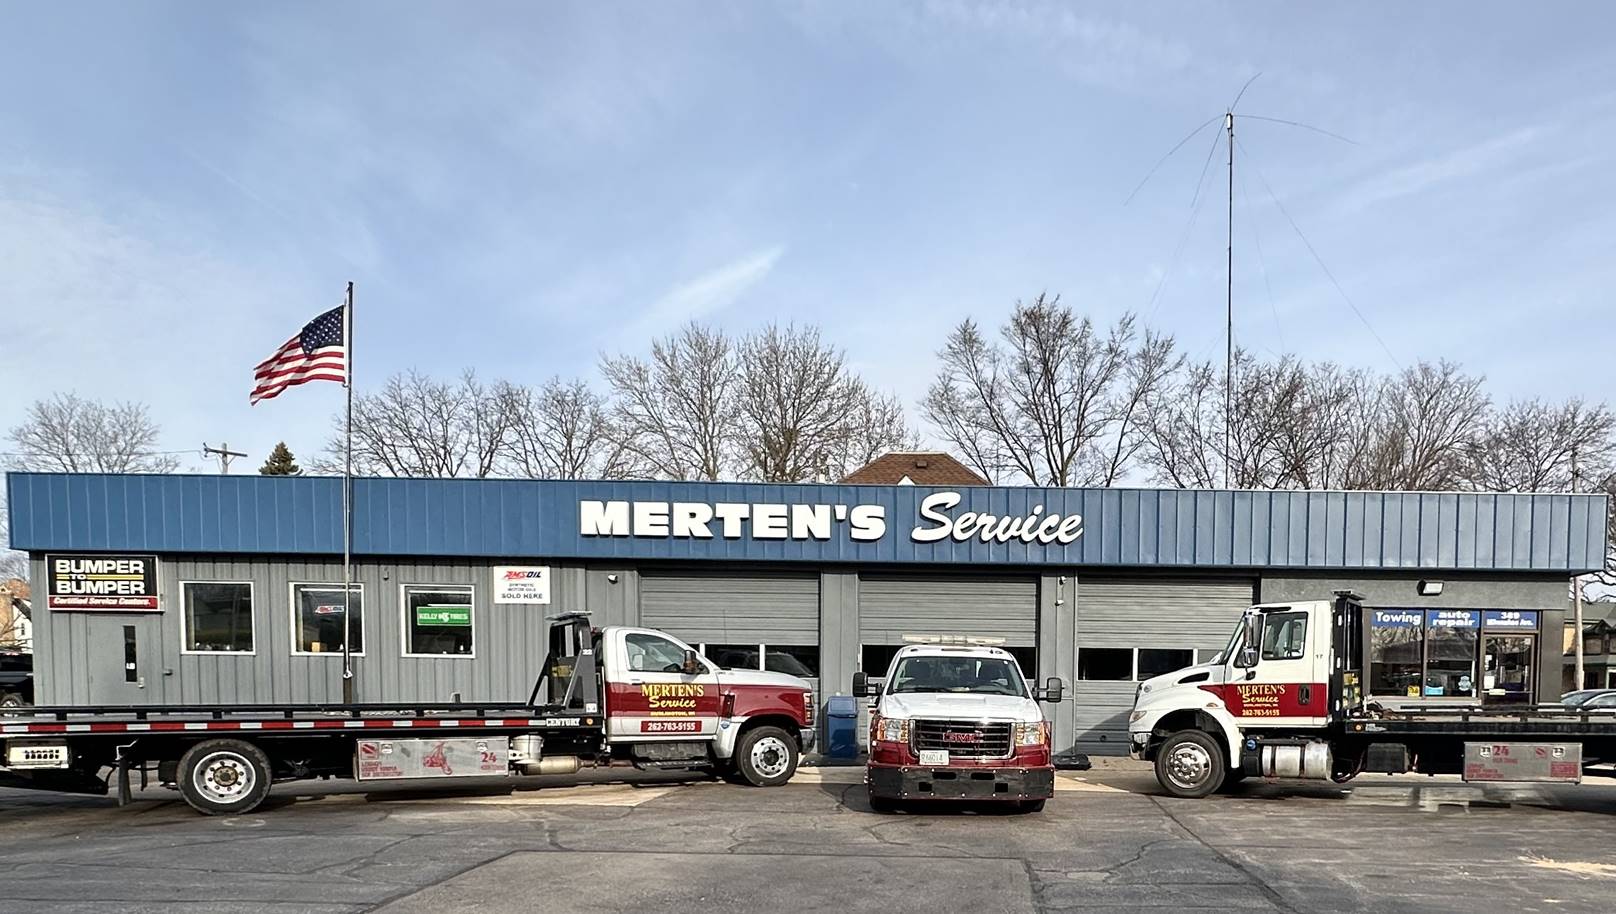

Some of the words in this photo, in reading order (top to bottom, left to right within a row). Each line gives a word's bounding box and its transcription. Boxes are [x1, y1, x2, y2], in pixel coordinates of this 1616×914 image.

[580, 500, 886, 541] MERTEN'S
[910, 490, 1084, 545] Service
[55, 559, 144, 574] BUMPER
[503, 571, 541, 580] AMSOIL
[56, 580, 145, 594] BUMPER
[1375, 611, 1422, 625] Towing
[1438, 611, 1471, 619] auto
[1432, 617, 1476, 627] repair
[641, 684, 704, 697] MERTEN'S
[1237, 684, 1286, 695] MERTEN'S
[648, 695, 697, 708] Service
[1242, 694, 1279, 703] Service
[546, 718, 580, 727] CENTURY
[1493, 745, 1509, 756] 24
[481, 752, 497, 762] 24
